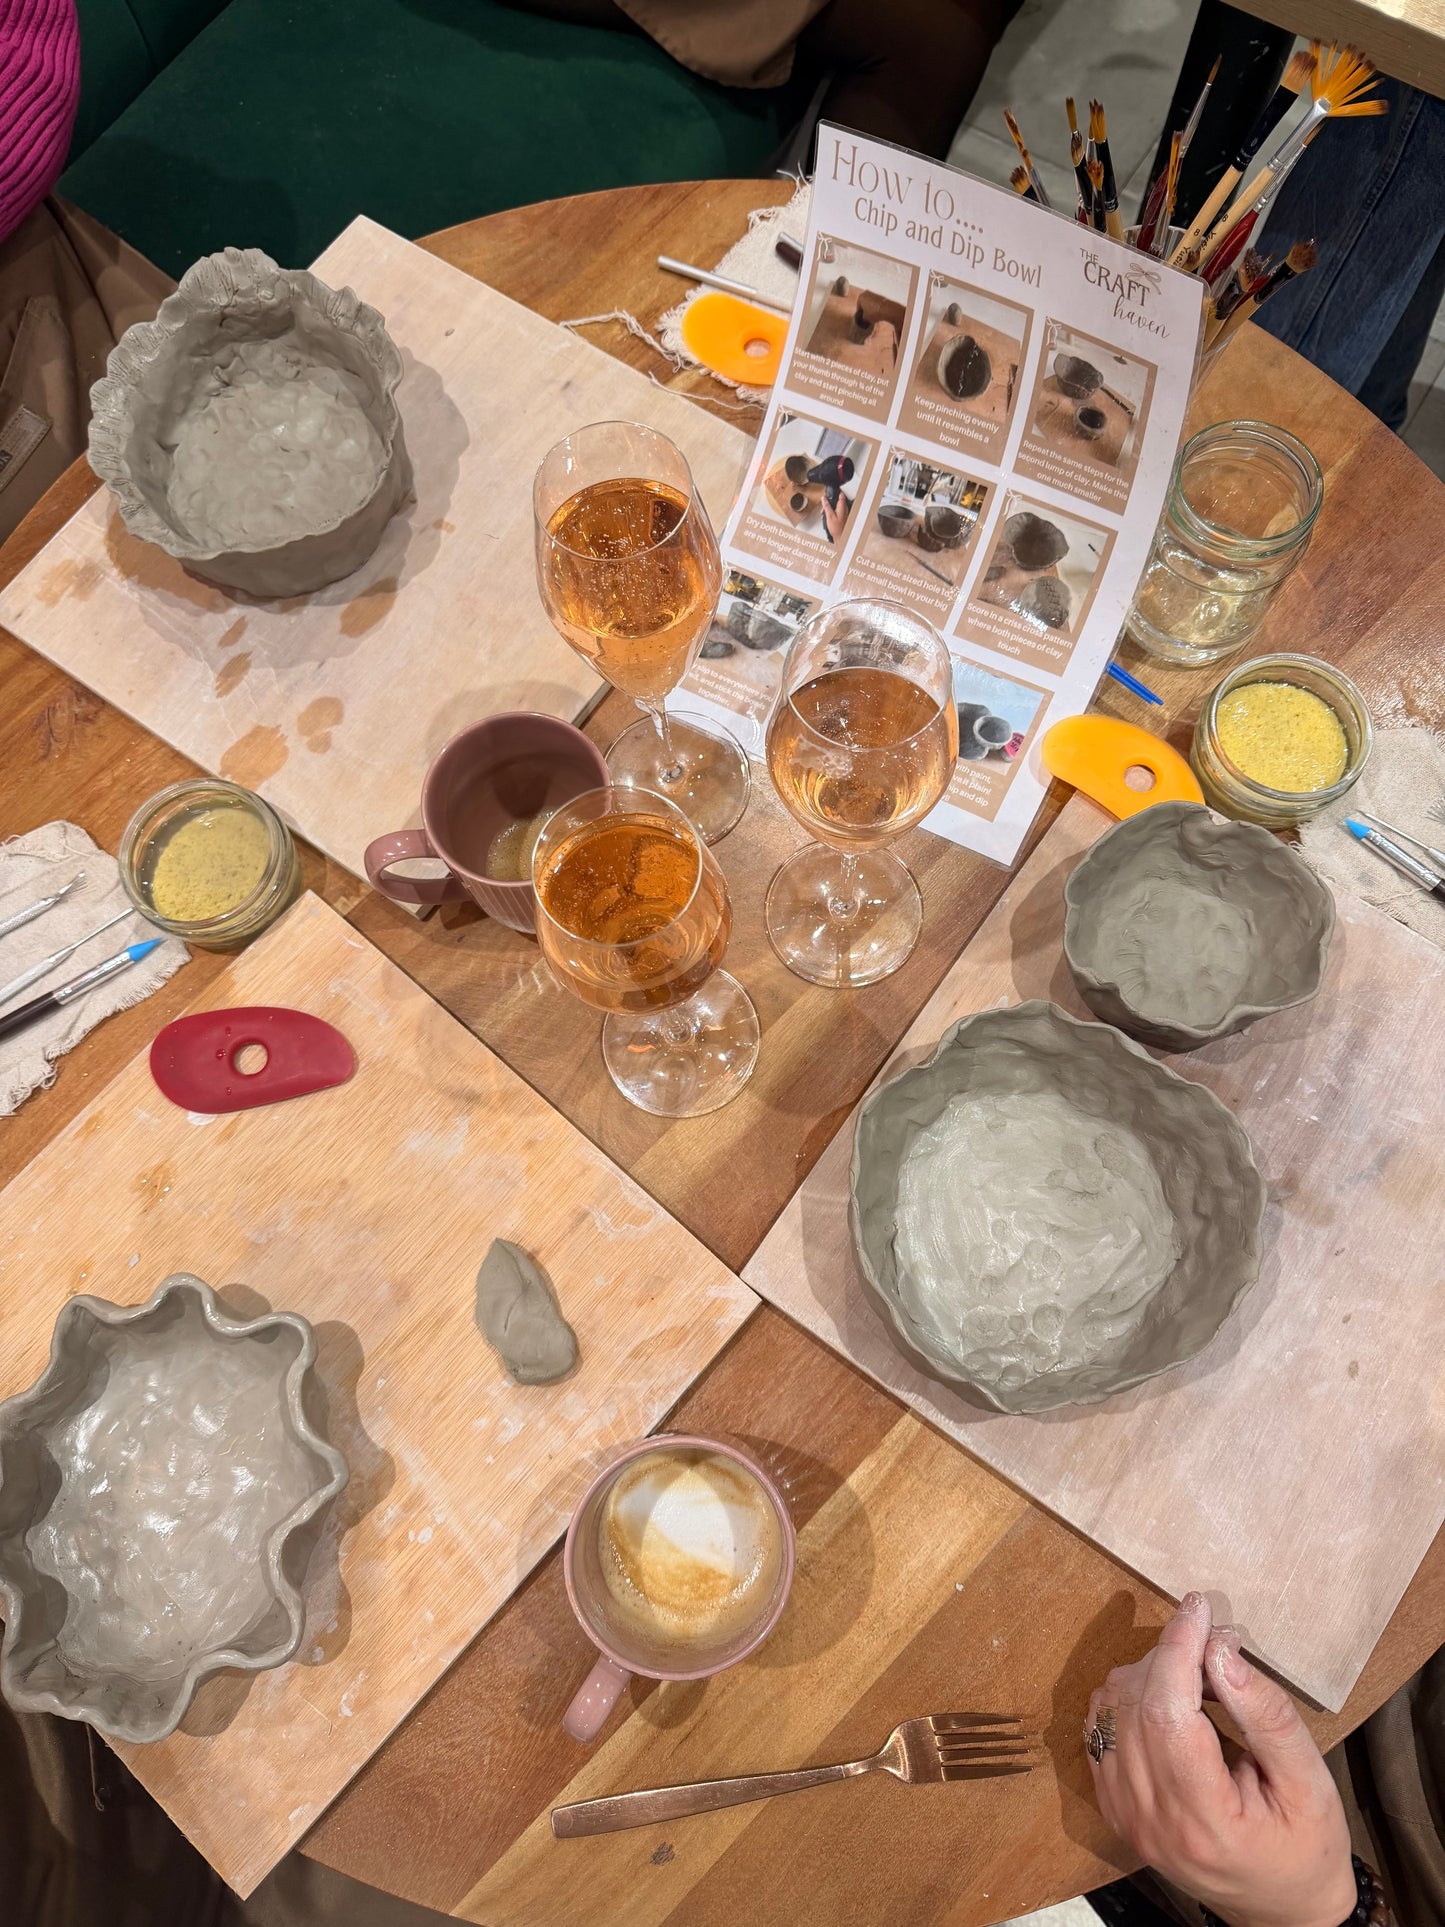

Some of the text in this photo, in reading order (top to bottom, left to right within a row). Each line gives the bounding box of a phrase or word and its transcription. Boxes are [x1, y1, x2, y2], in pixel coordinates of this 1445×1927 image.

[854, 197, 1042, 288] Chip and Dip Bowl
[1193, 228, 1201, 236] 8
[1080, 248, 1099, 264] THE
[1084, 261, 1150, 306] CRAFT
[1113, 294, 1170, 339] haven
[793, 360, 809, 370] your
[809, 364, 831, 377] thumb
[831, 371, 860, 387] through
[865, 385, 873, 393] of
[873, 387, 885, 397] the
[794, 371, 877, 407] clay and start pinching all
[830, 360, 853, 374] pieces
[853, 367, 862, 377] of
[876, 377, 890, 387] put
[819, 393, 845, 407] around
[914, 394, 1000, 434] Keep pinching evenly
[916, 411, 990, 444] until it resembles a
[939, 432, 960, 447] bowl
[1018, 452, 1045, 467] second
[1045, 460, 1065, 475] lump
[1065, 469, 1074, 479] of
[1091, 479, 1113, 494] Make
[1113, 488, 1129, 501] this
[1022, 440, 1130, 489] Repeat the same steps for the
[1036, 472, 1102, 502] one much smaller
[743, 529, 831, 569] are no longer damp and
[746, 516, 838, 559] Dry both bowls until they
[770, 552, 794, 569] flimsy
[855, 555, 870, 566] Cut
[870, 561, 876, 569] a
[875, 562, 902, 578] similar
[902, 573, 923, 587] sized
[922, 580, 941, 594] hole
[847, 567, 948, 612] your small bowl in your big
[966, 602, 1073, 649] Score in a criss cross pattern
[967, 616, 1063, 660] where both pieces of clay
[997, 640, 1021, 656] touch
[702, 677, 715, 687] and
[731, 690, 745, 701] the
[718, 674, 759, 697] everywhere
[959, 790, 976, 801] and
[975, 794, 989, 807] dip
